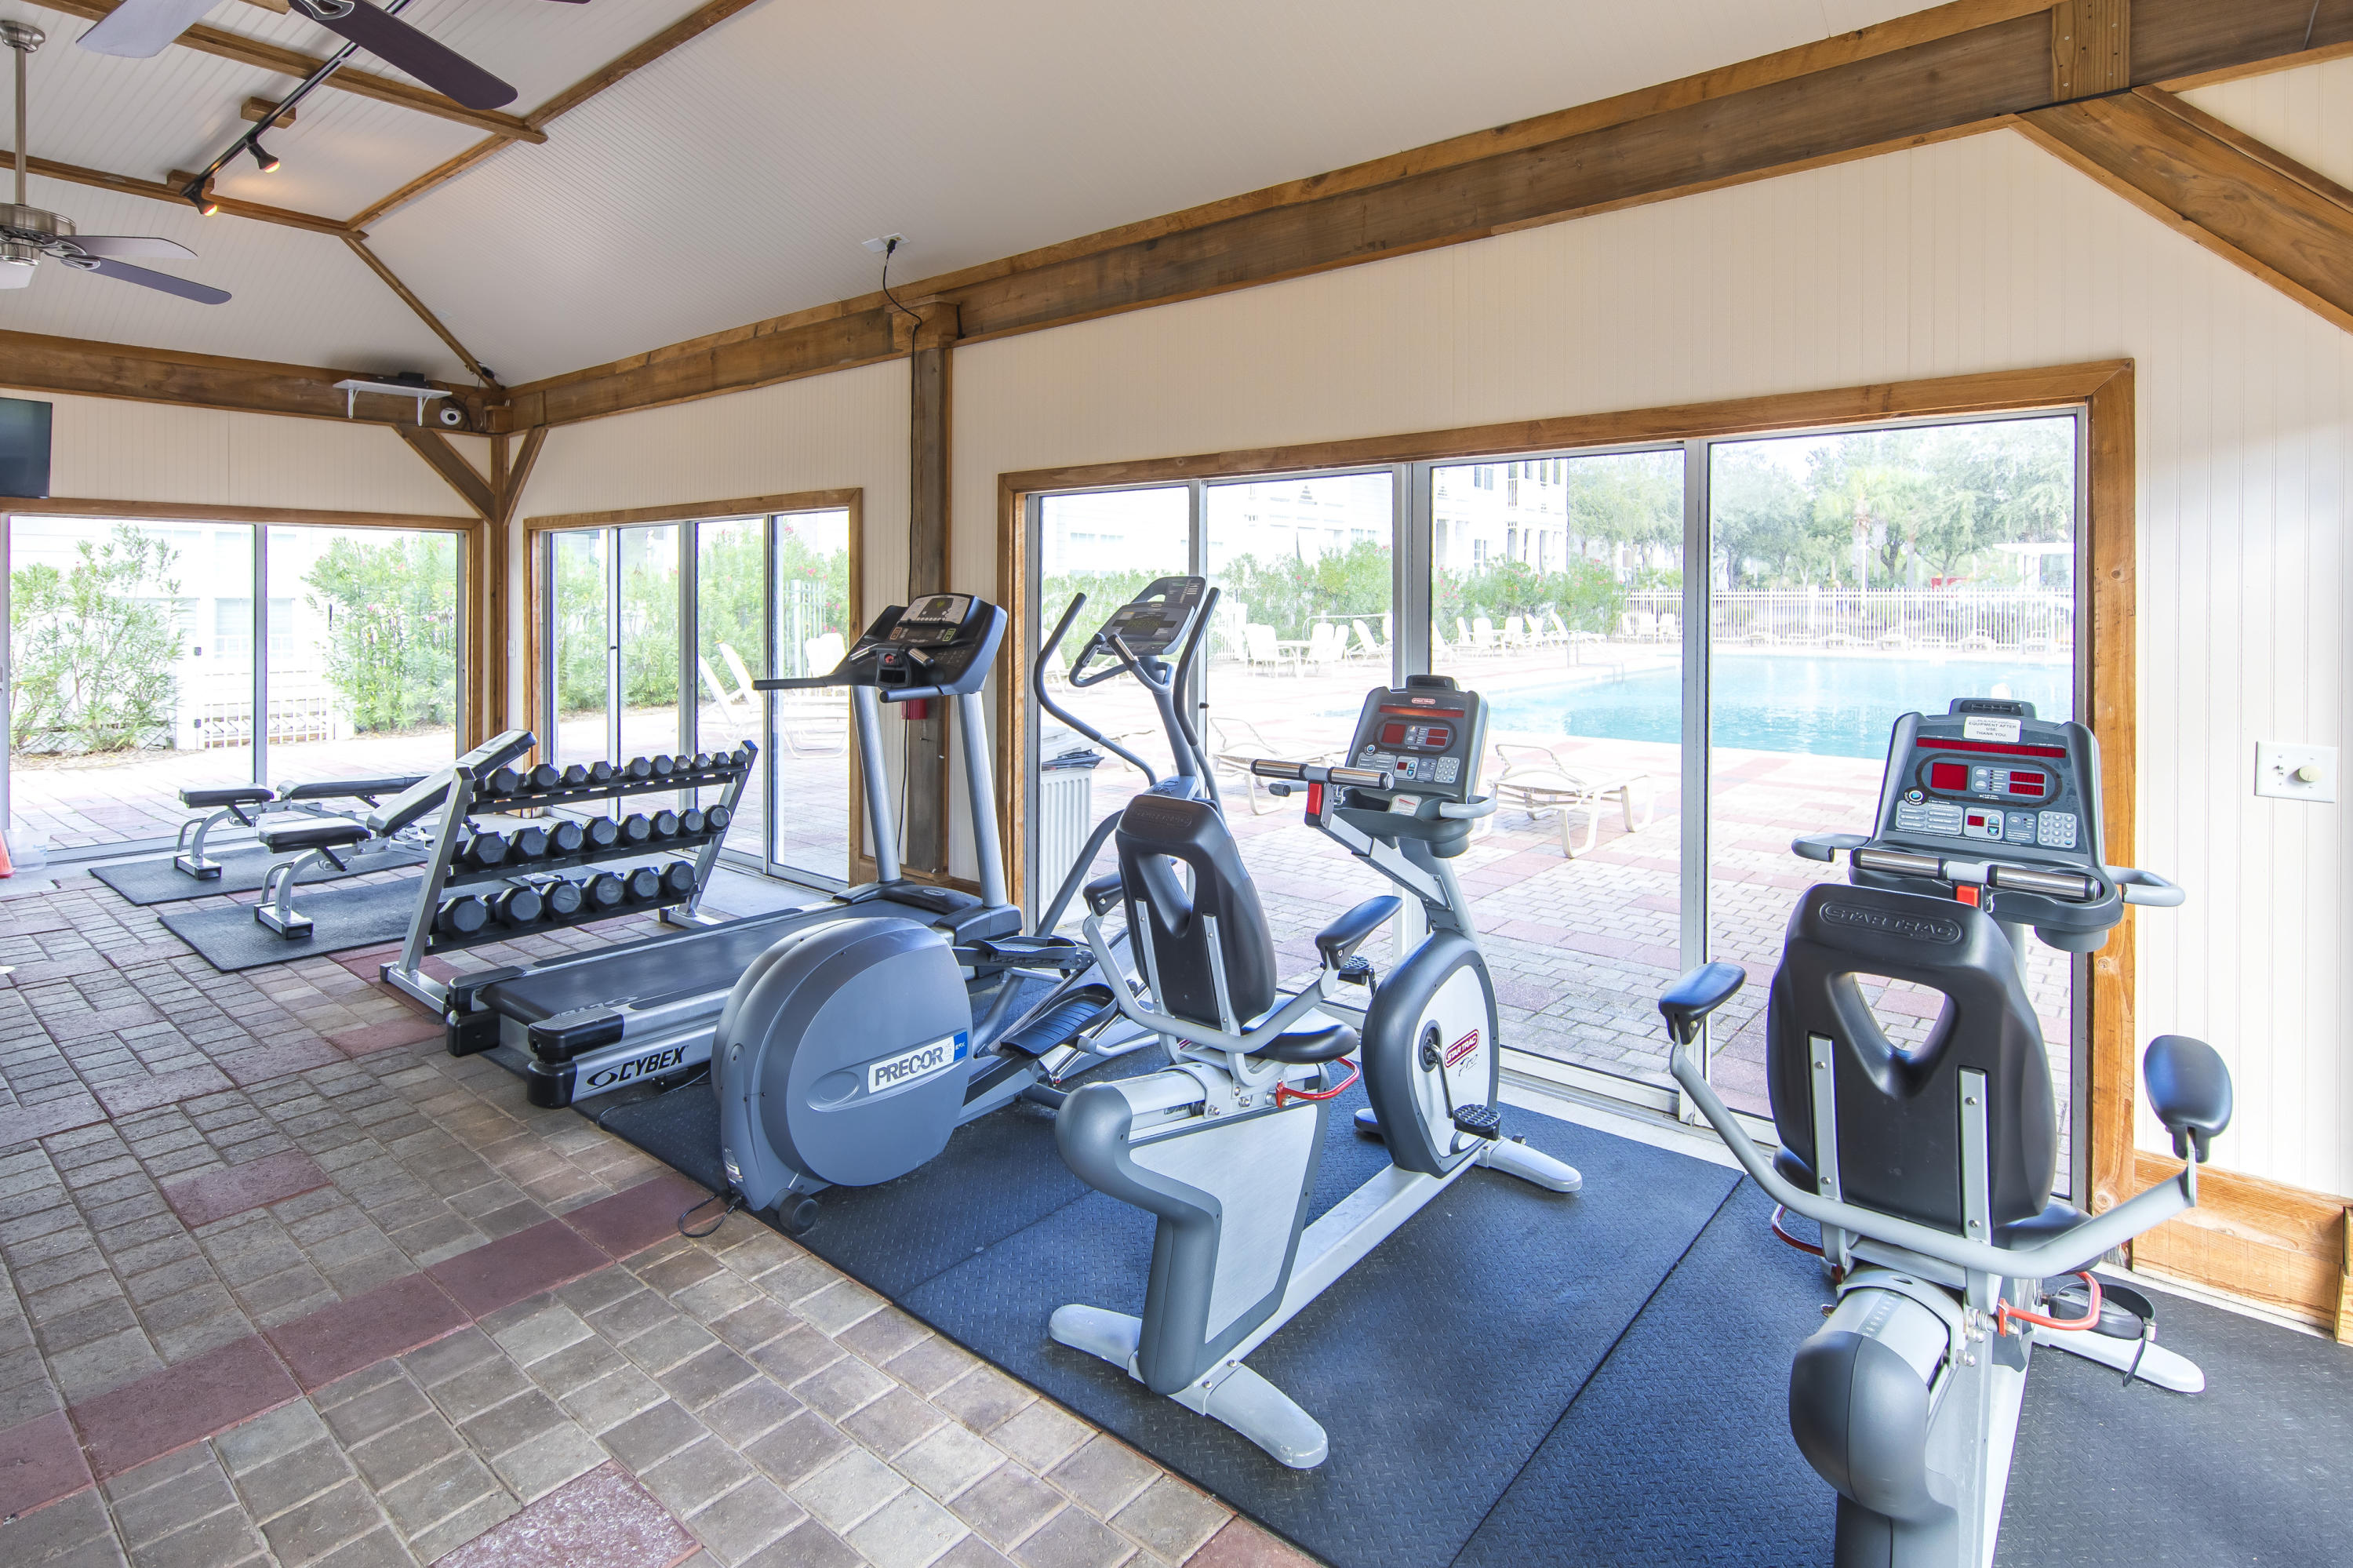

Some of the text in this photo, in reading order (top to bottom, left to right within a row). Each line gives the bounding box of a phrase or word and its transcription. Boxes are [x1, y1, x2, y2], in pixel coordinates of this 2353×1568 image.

[1825, 904, 1954, 937] STAR TRAC
[618, 1045, 686, 1082] CYBEX
[875, 1046, 944, 1086] PRECOR
[1447, 1035, 1478, 1062] STAR TRAC
